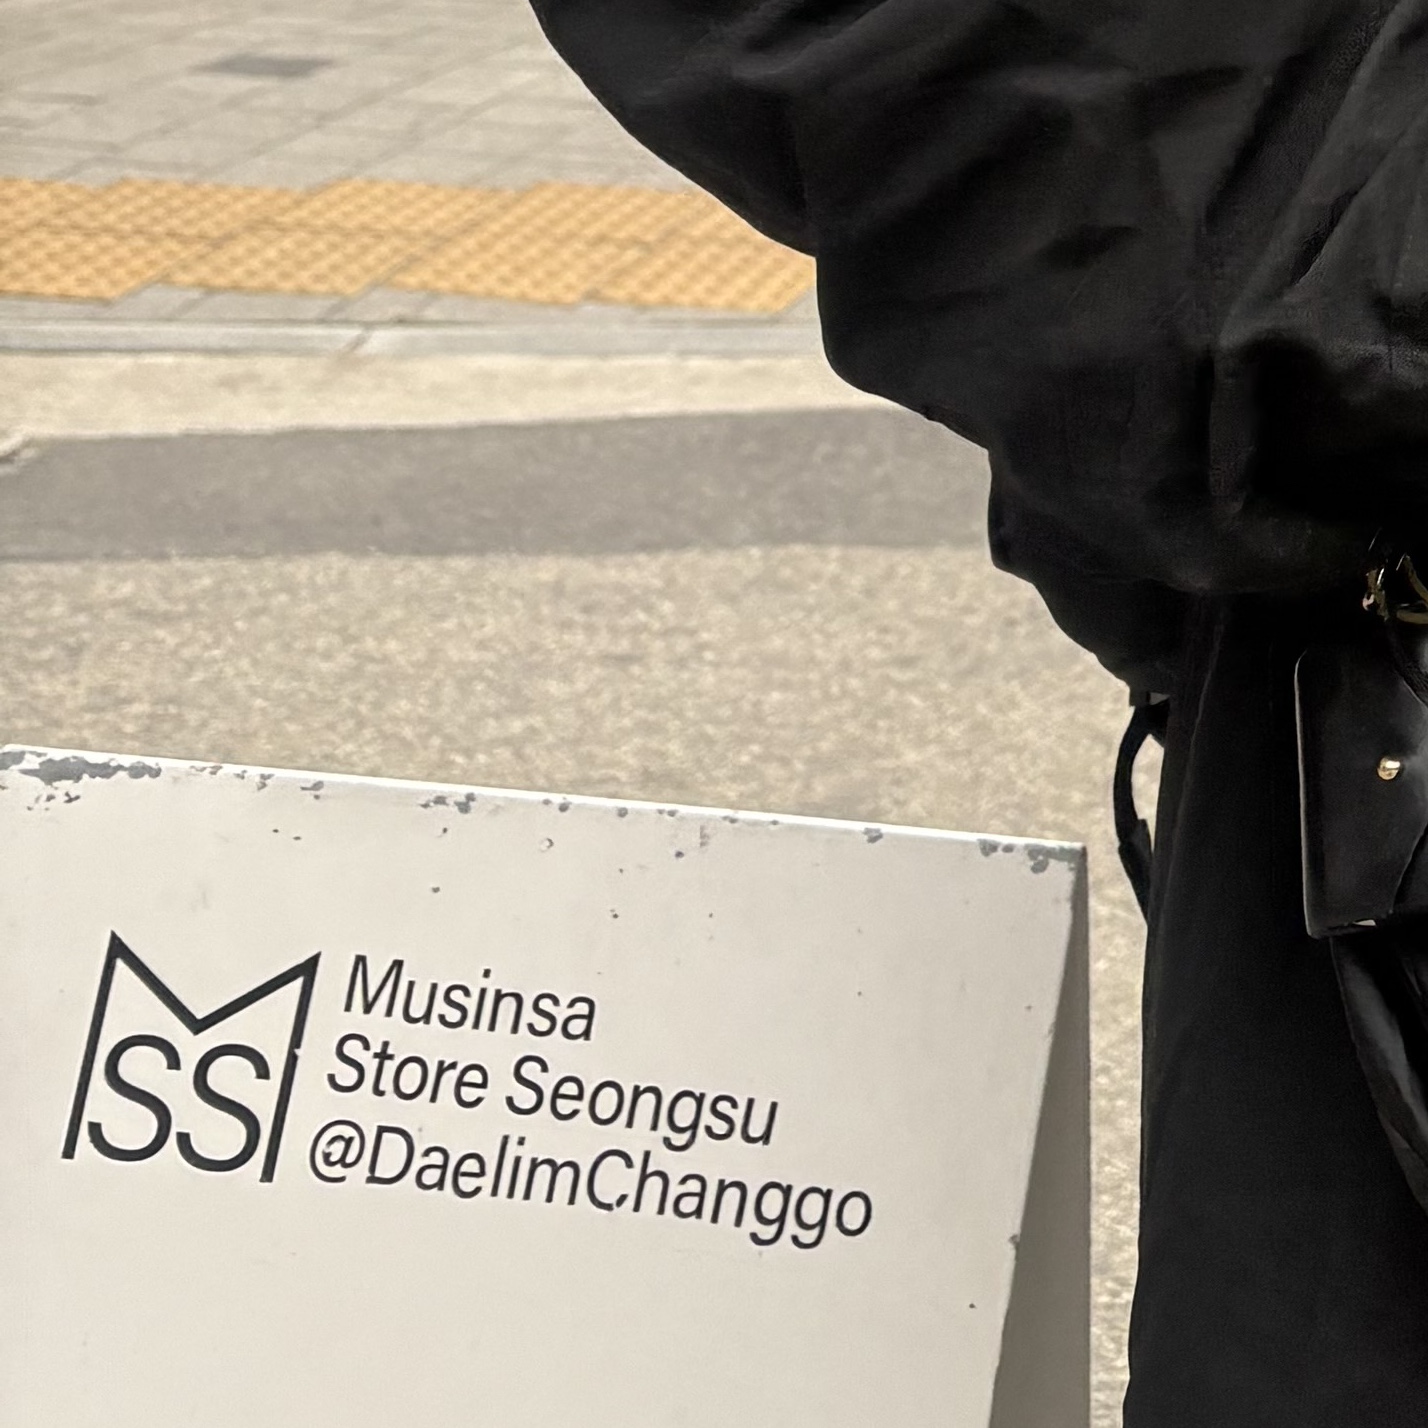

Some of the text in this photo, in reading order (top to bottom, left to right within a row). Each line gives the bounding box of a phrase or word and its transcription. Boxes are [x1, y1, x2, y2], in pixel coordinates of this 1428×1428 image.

[345, 955, 595, 1041] Musinsa
[328, 1034, 777, 1152] Store Seongsu
[310, 1120, 871, 1250] @DaelimChanggo
